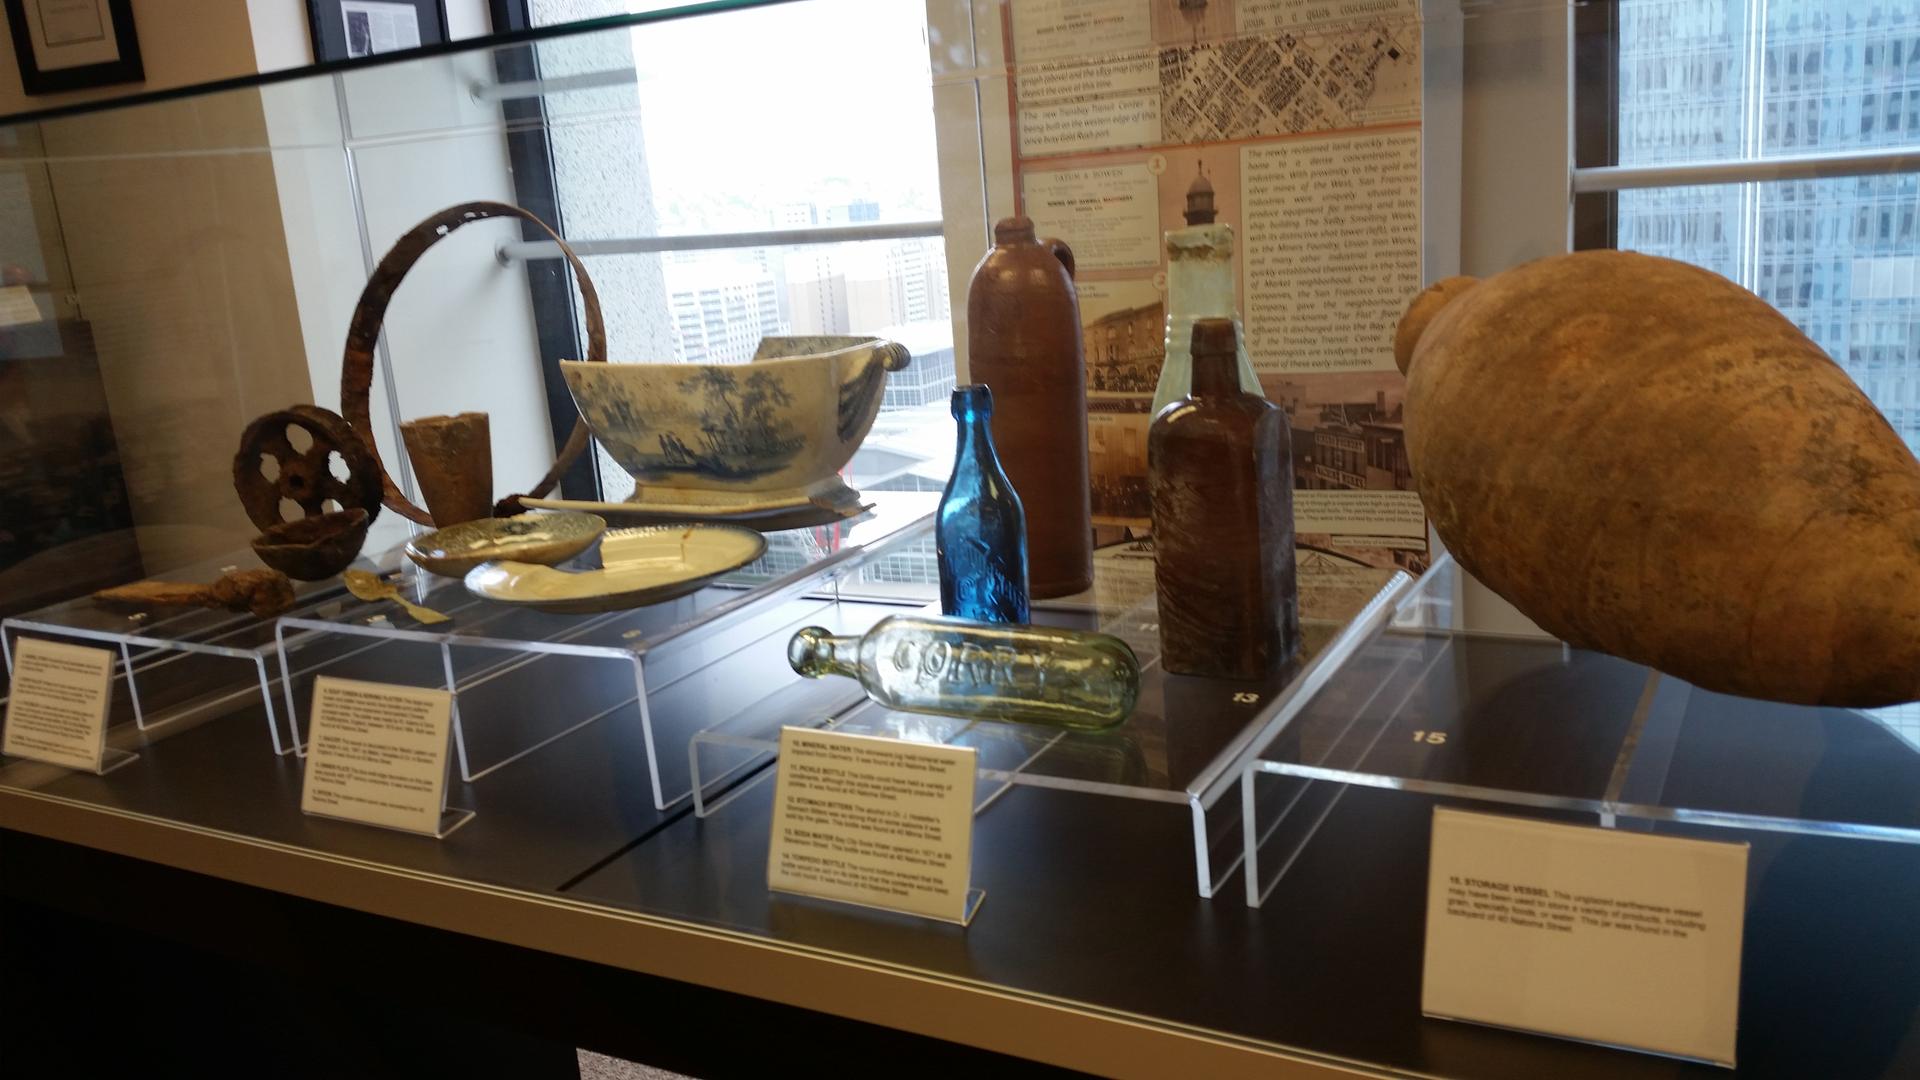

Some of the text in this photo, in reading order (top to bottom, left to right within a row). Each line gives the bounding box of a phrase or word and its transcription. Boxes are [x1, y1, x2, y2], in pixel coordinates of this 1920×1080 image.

[1264, 147, 1287, 160] newly
[1291, 143, 1329, 154] reclaimed
[1354, 138, 1382, 151] quickly
[1387, 134, 1417, 145] became
[1248, 161, 1269, 171] home
[1309, 155, 1333, 165] dense
[1343, 148, 1400, 162] concentration
[1289, 170, 1307, 179] With
[1310, 166, 1348, 180] proximity
[1364, 163, 1378, 172] the
[1381, 161, 1400, 174] gold
[1402, 160, 1417, 169] and
[1313, 180, 1327, 189] the
[1358, 176, 1374, 185] San
[1380, 173, 1417, 184] Francisco
[1413, 730, 1447, 745] 15
[802, 741, 827, 749] MINERAL
[830, 744, 851, 752] WATER
[799, 765, 820, 774] PICKLE
[822, 768, 845, 777] BOTTLE
[797, 797, 826, 807] STOMACH
[828, 802, 852, 811] BITTERS
[812, 832, 833, 841] WATER
[822, 859, 845, 868] BOTTLE
[1447, 888, 1465, 898] may
[1467, 889, 1488, 899] have
[1490, 892, 1512, 902] been
[1464, 878, 1509, 891] STORAGE
[1512, 885, 1549, 896] VESSEL
[1553, 891, 1571, 899] This
